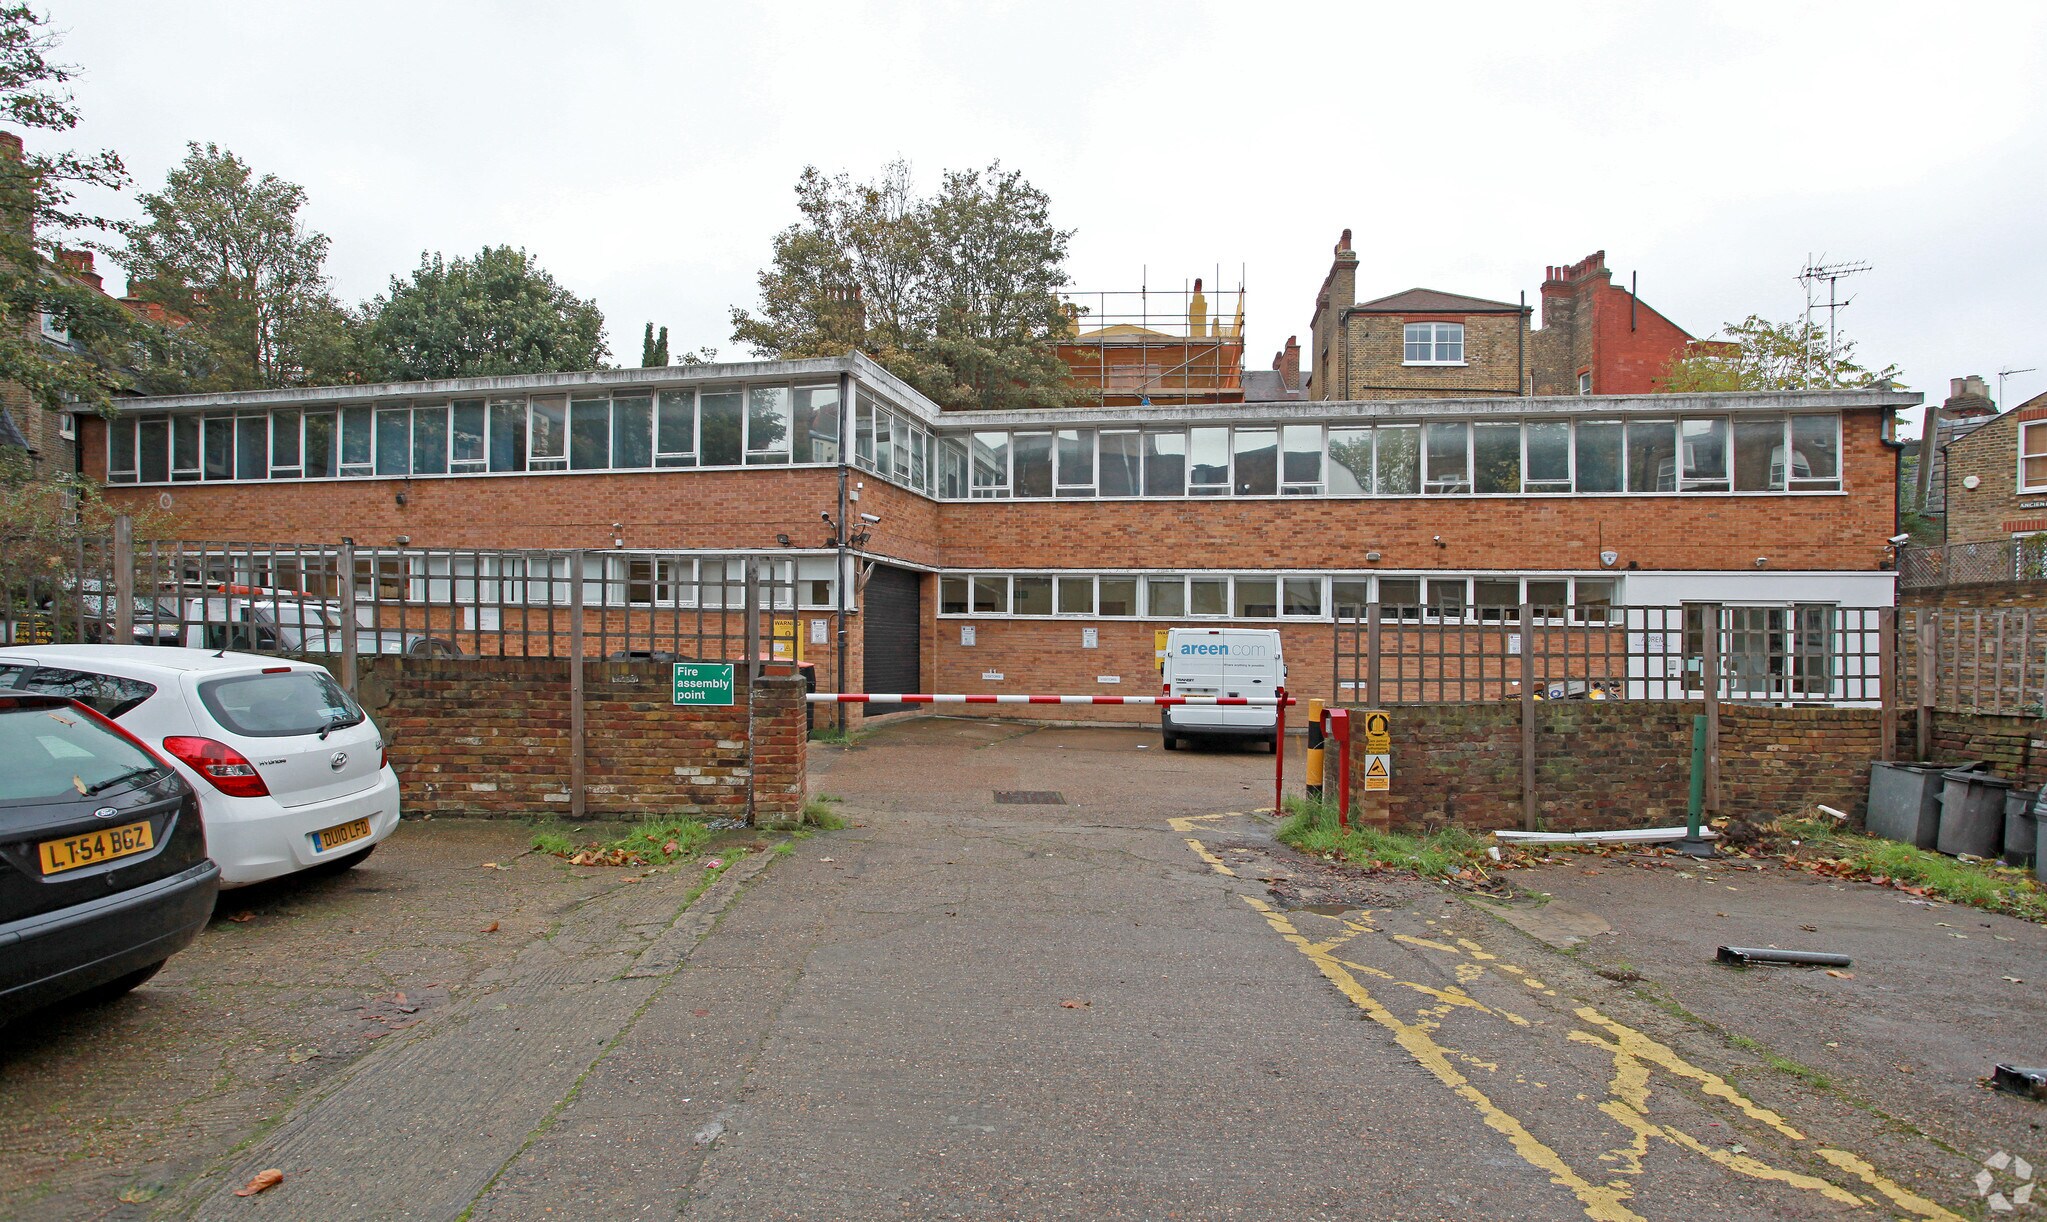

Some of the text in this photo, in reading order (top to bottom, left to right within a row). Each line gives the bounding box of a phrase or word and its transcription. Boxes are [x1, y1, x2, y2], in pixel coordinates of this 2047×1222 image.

[677, 667, 699, 676] Fire
[677, 679, 730, 691] assembly
[677, 690, 706, 701] point
[323, 821, 368, 847] DU10 LFD
[49, 827, 146, 868] LT54 BGZ
